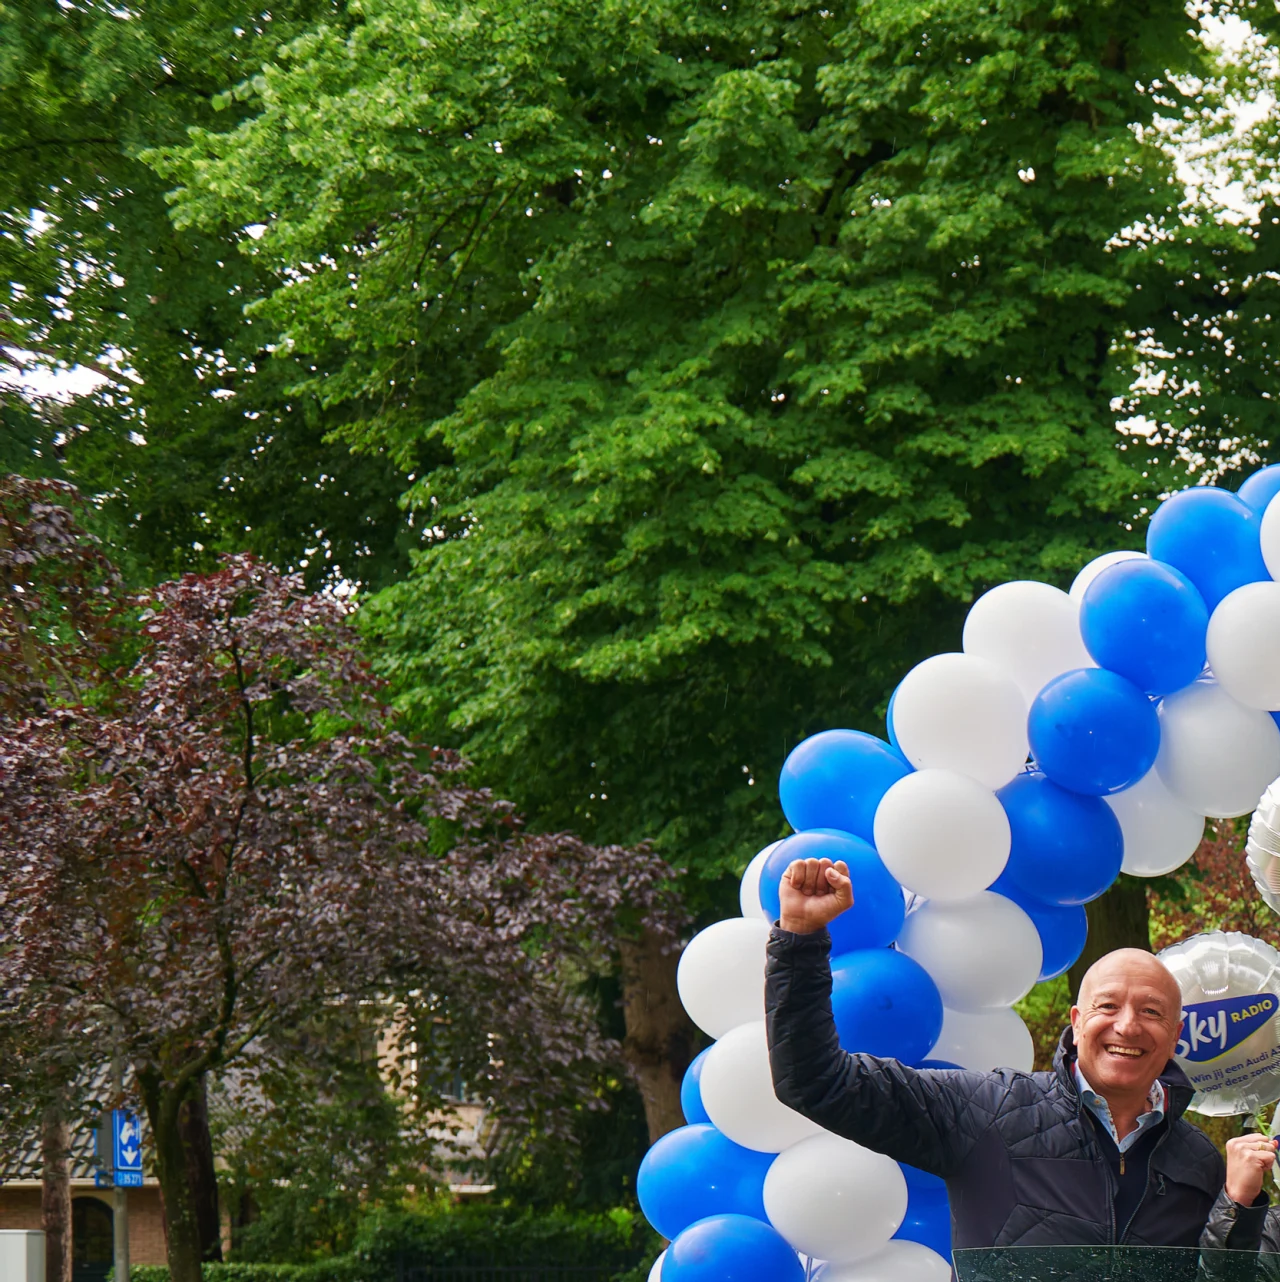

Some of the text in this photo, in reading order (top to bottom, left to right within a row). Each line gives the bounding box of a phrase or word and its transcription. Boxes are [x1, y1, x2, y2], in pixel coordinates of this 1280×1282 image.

[1230, 1000, 1273, 1023] RADIO
[1190, 1073, 1212, 1084] Win
[1213, 1068, 1224, 1081] jij
[1225, 1063, 1244, 1074] een
[1246, 1052, 1269, 1067] Audi
[1199, 1082, 1223, 1094] voor
[1225, 1074, 1249, 1087] deze
